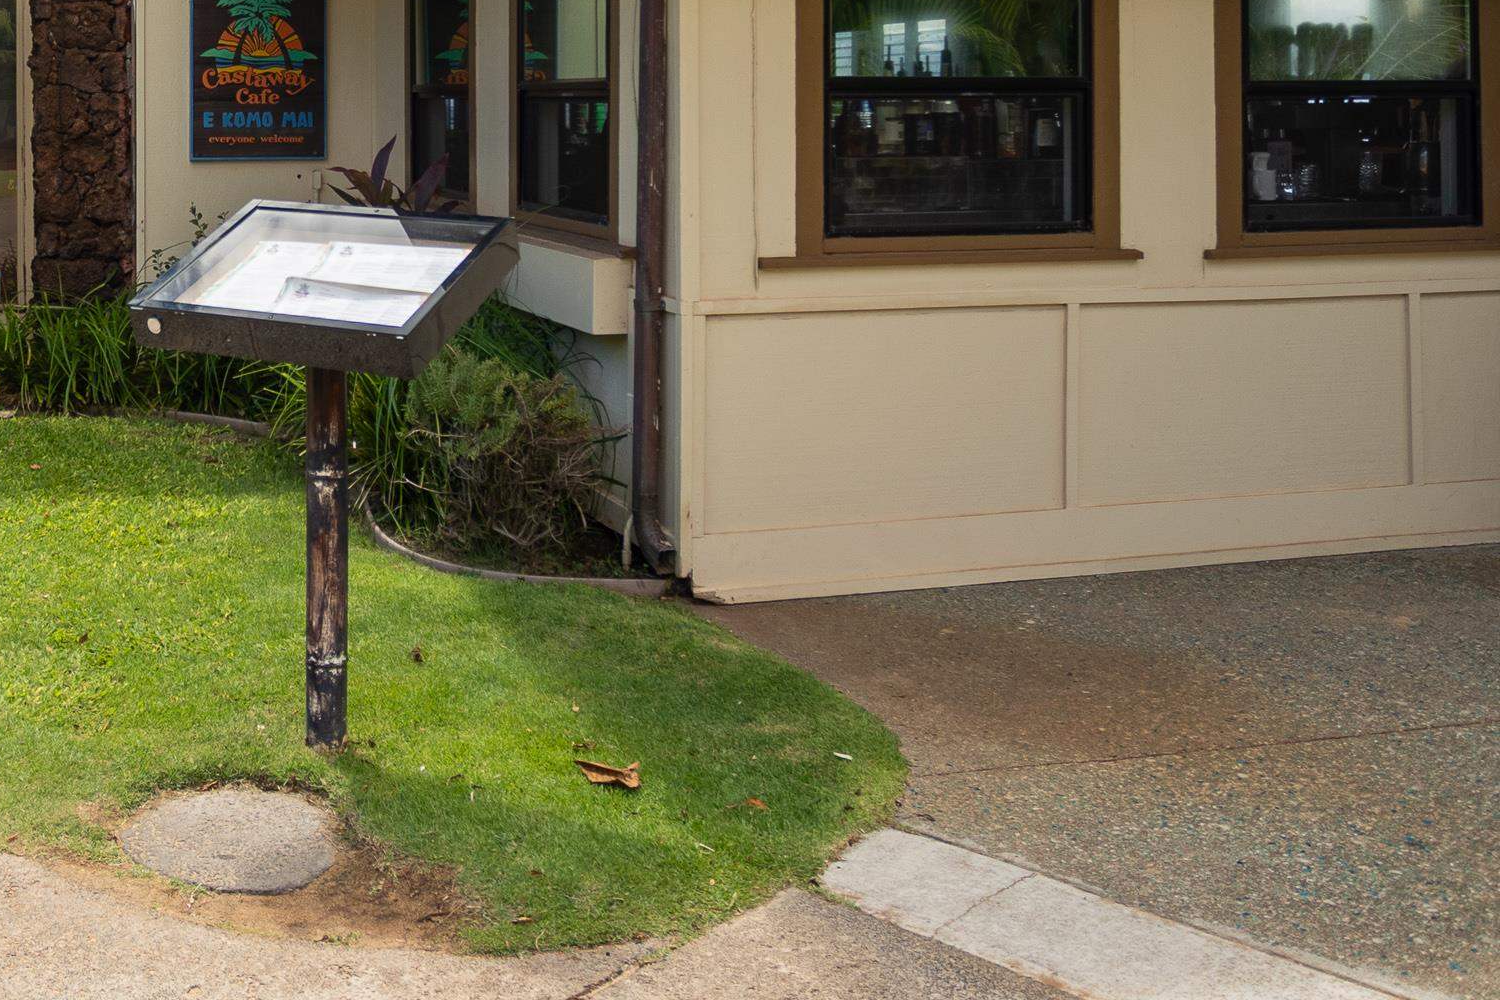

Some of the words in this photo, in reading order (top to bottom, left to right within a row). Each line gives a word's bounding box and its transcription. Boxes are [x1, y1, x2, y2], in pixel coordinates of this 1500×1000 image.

[202, 67, 316, 95] Castaway
[235, 87, 280, 105] Cafe
[203, 111, 214, 129] E
[222, 111, 274, 129] KOMO
[282, 111, 314, 129] MAI
[208, 135, 256, 145] everyone
[260, 134, 304, 144] welcome
